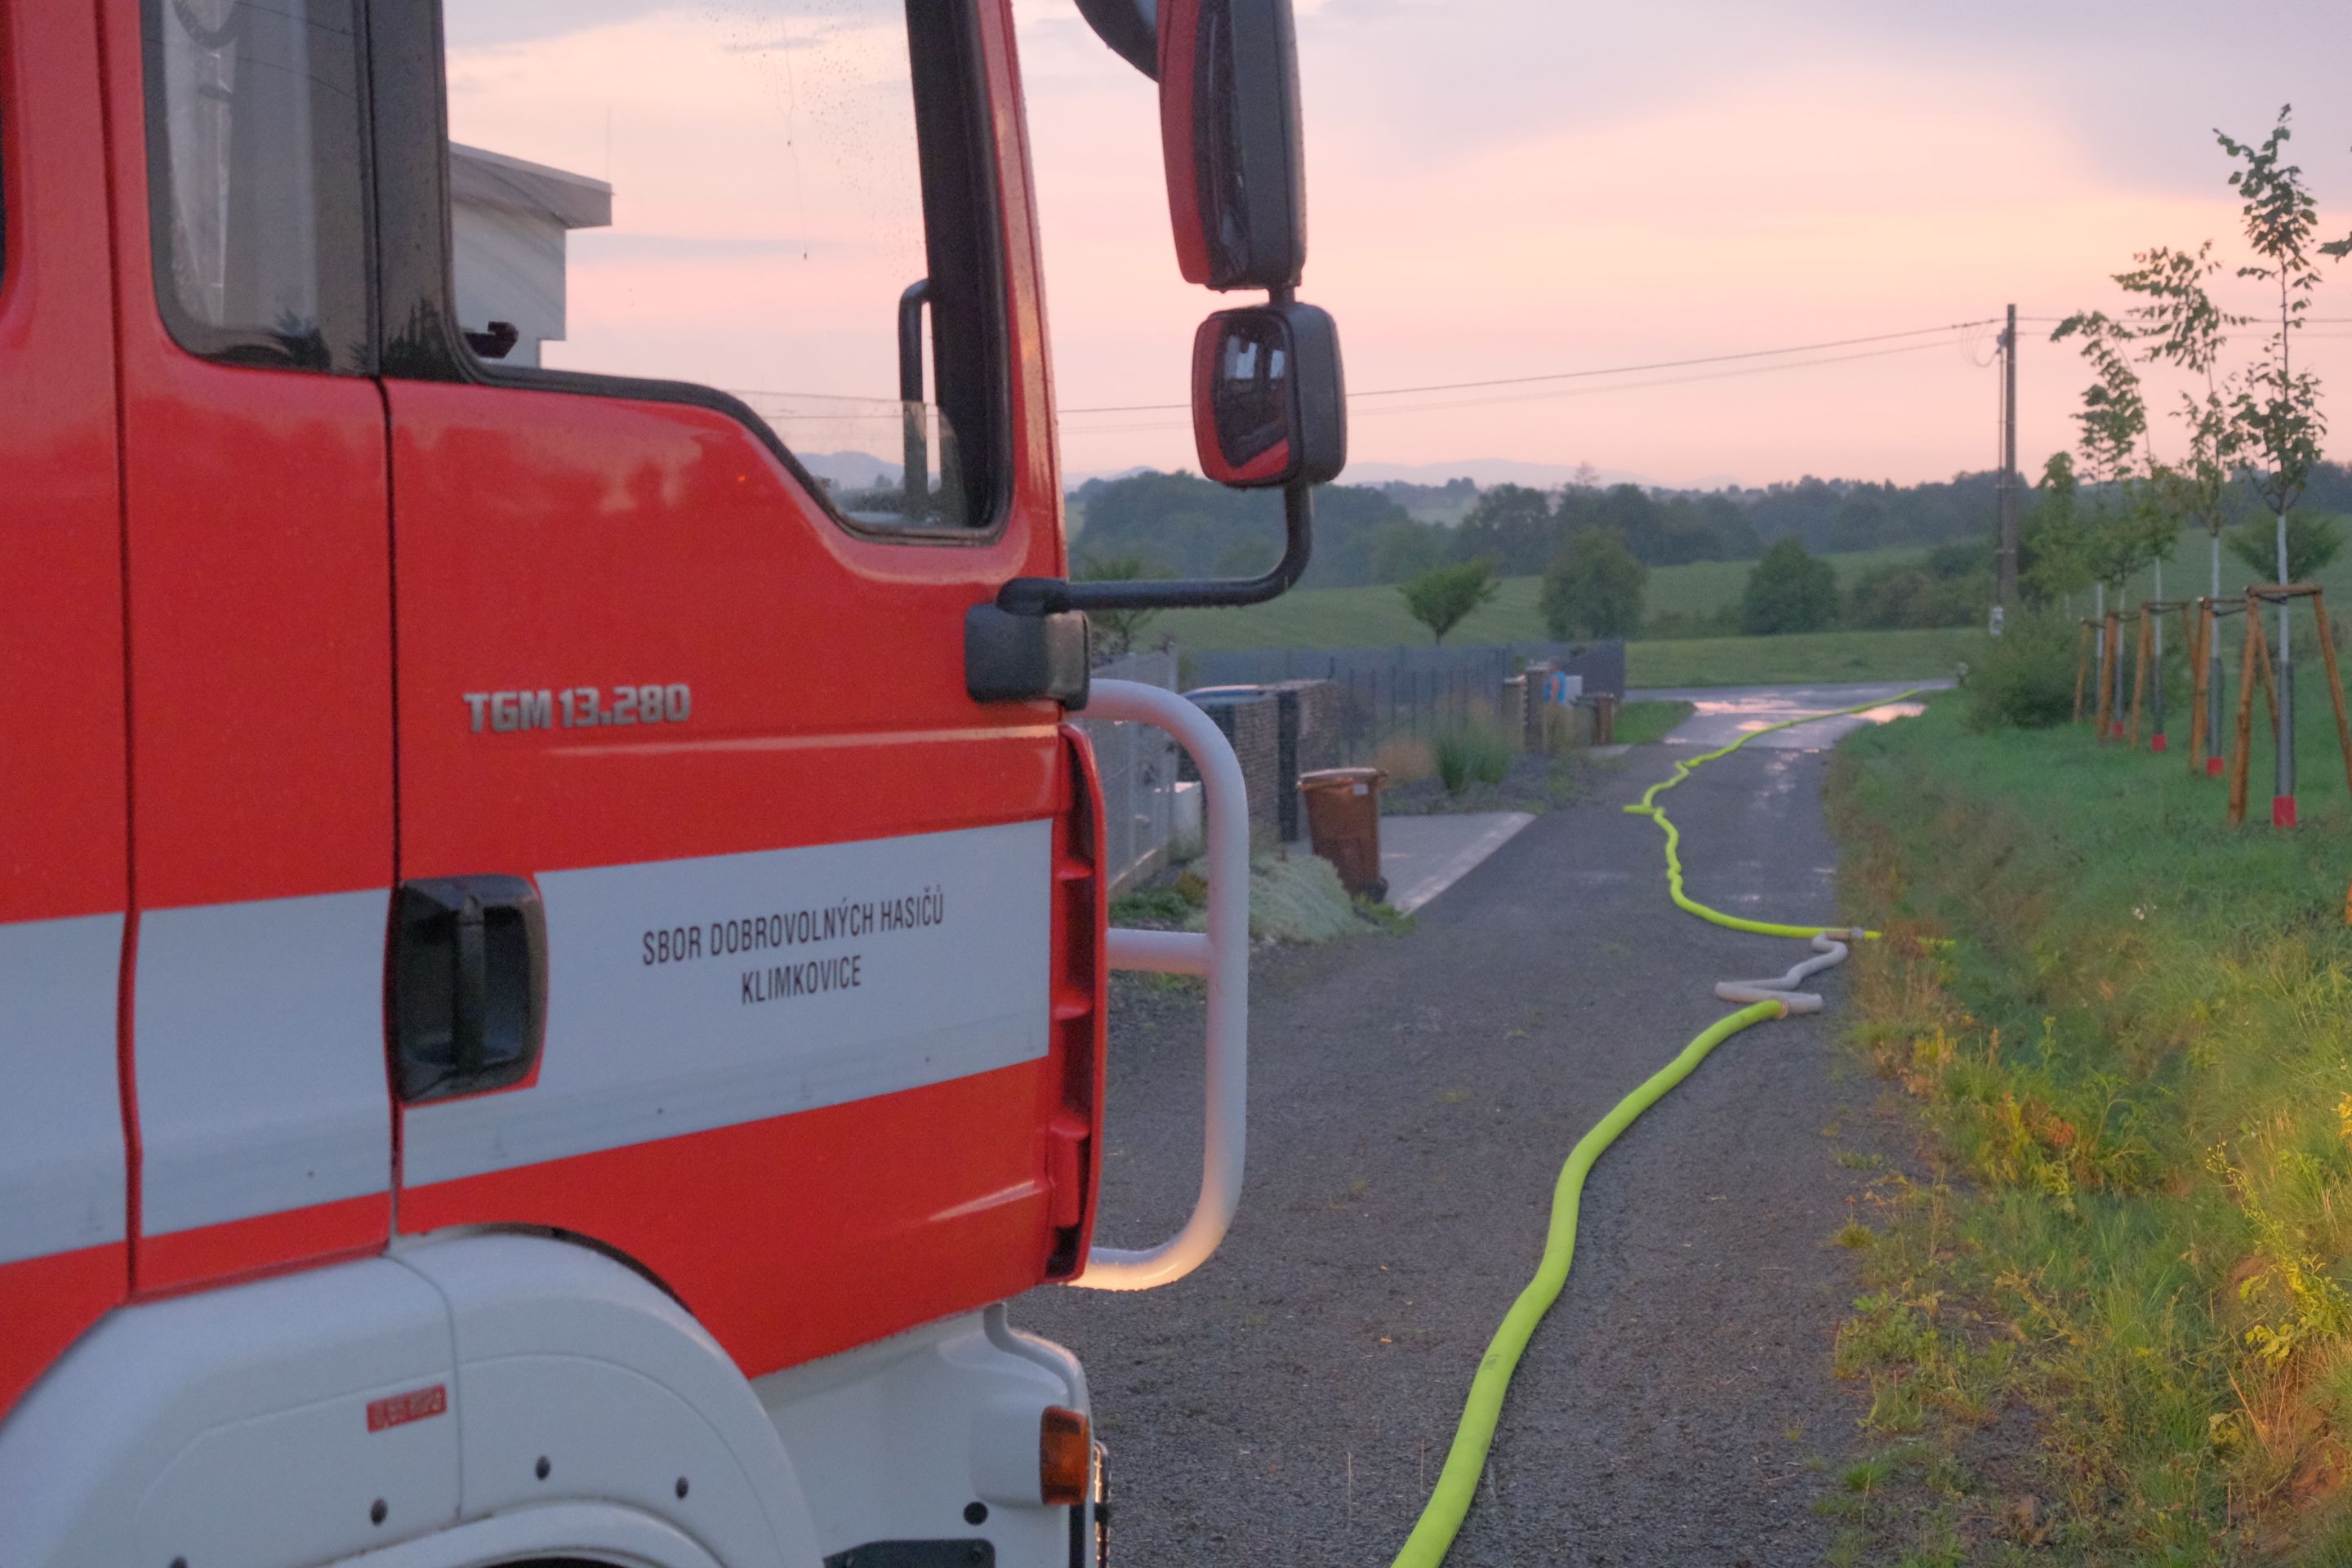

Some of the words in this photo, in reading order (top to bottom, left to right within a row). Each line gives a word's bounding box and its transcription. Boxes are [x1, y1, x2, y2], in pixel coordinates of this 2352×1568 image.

[463, 689, 551, 733] TGM
[559, 683, 690, 727] 13.280
[643, 925, 702, 965] SBOR
[710, 898, 873, 956] DOBROVOLNÝCH
[880, 884, 944, 931] HASIČŮ
[742, 955, 862, 1004] KLIMKOVICE
